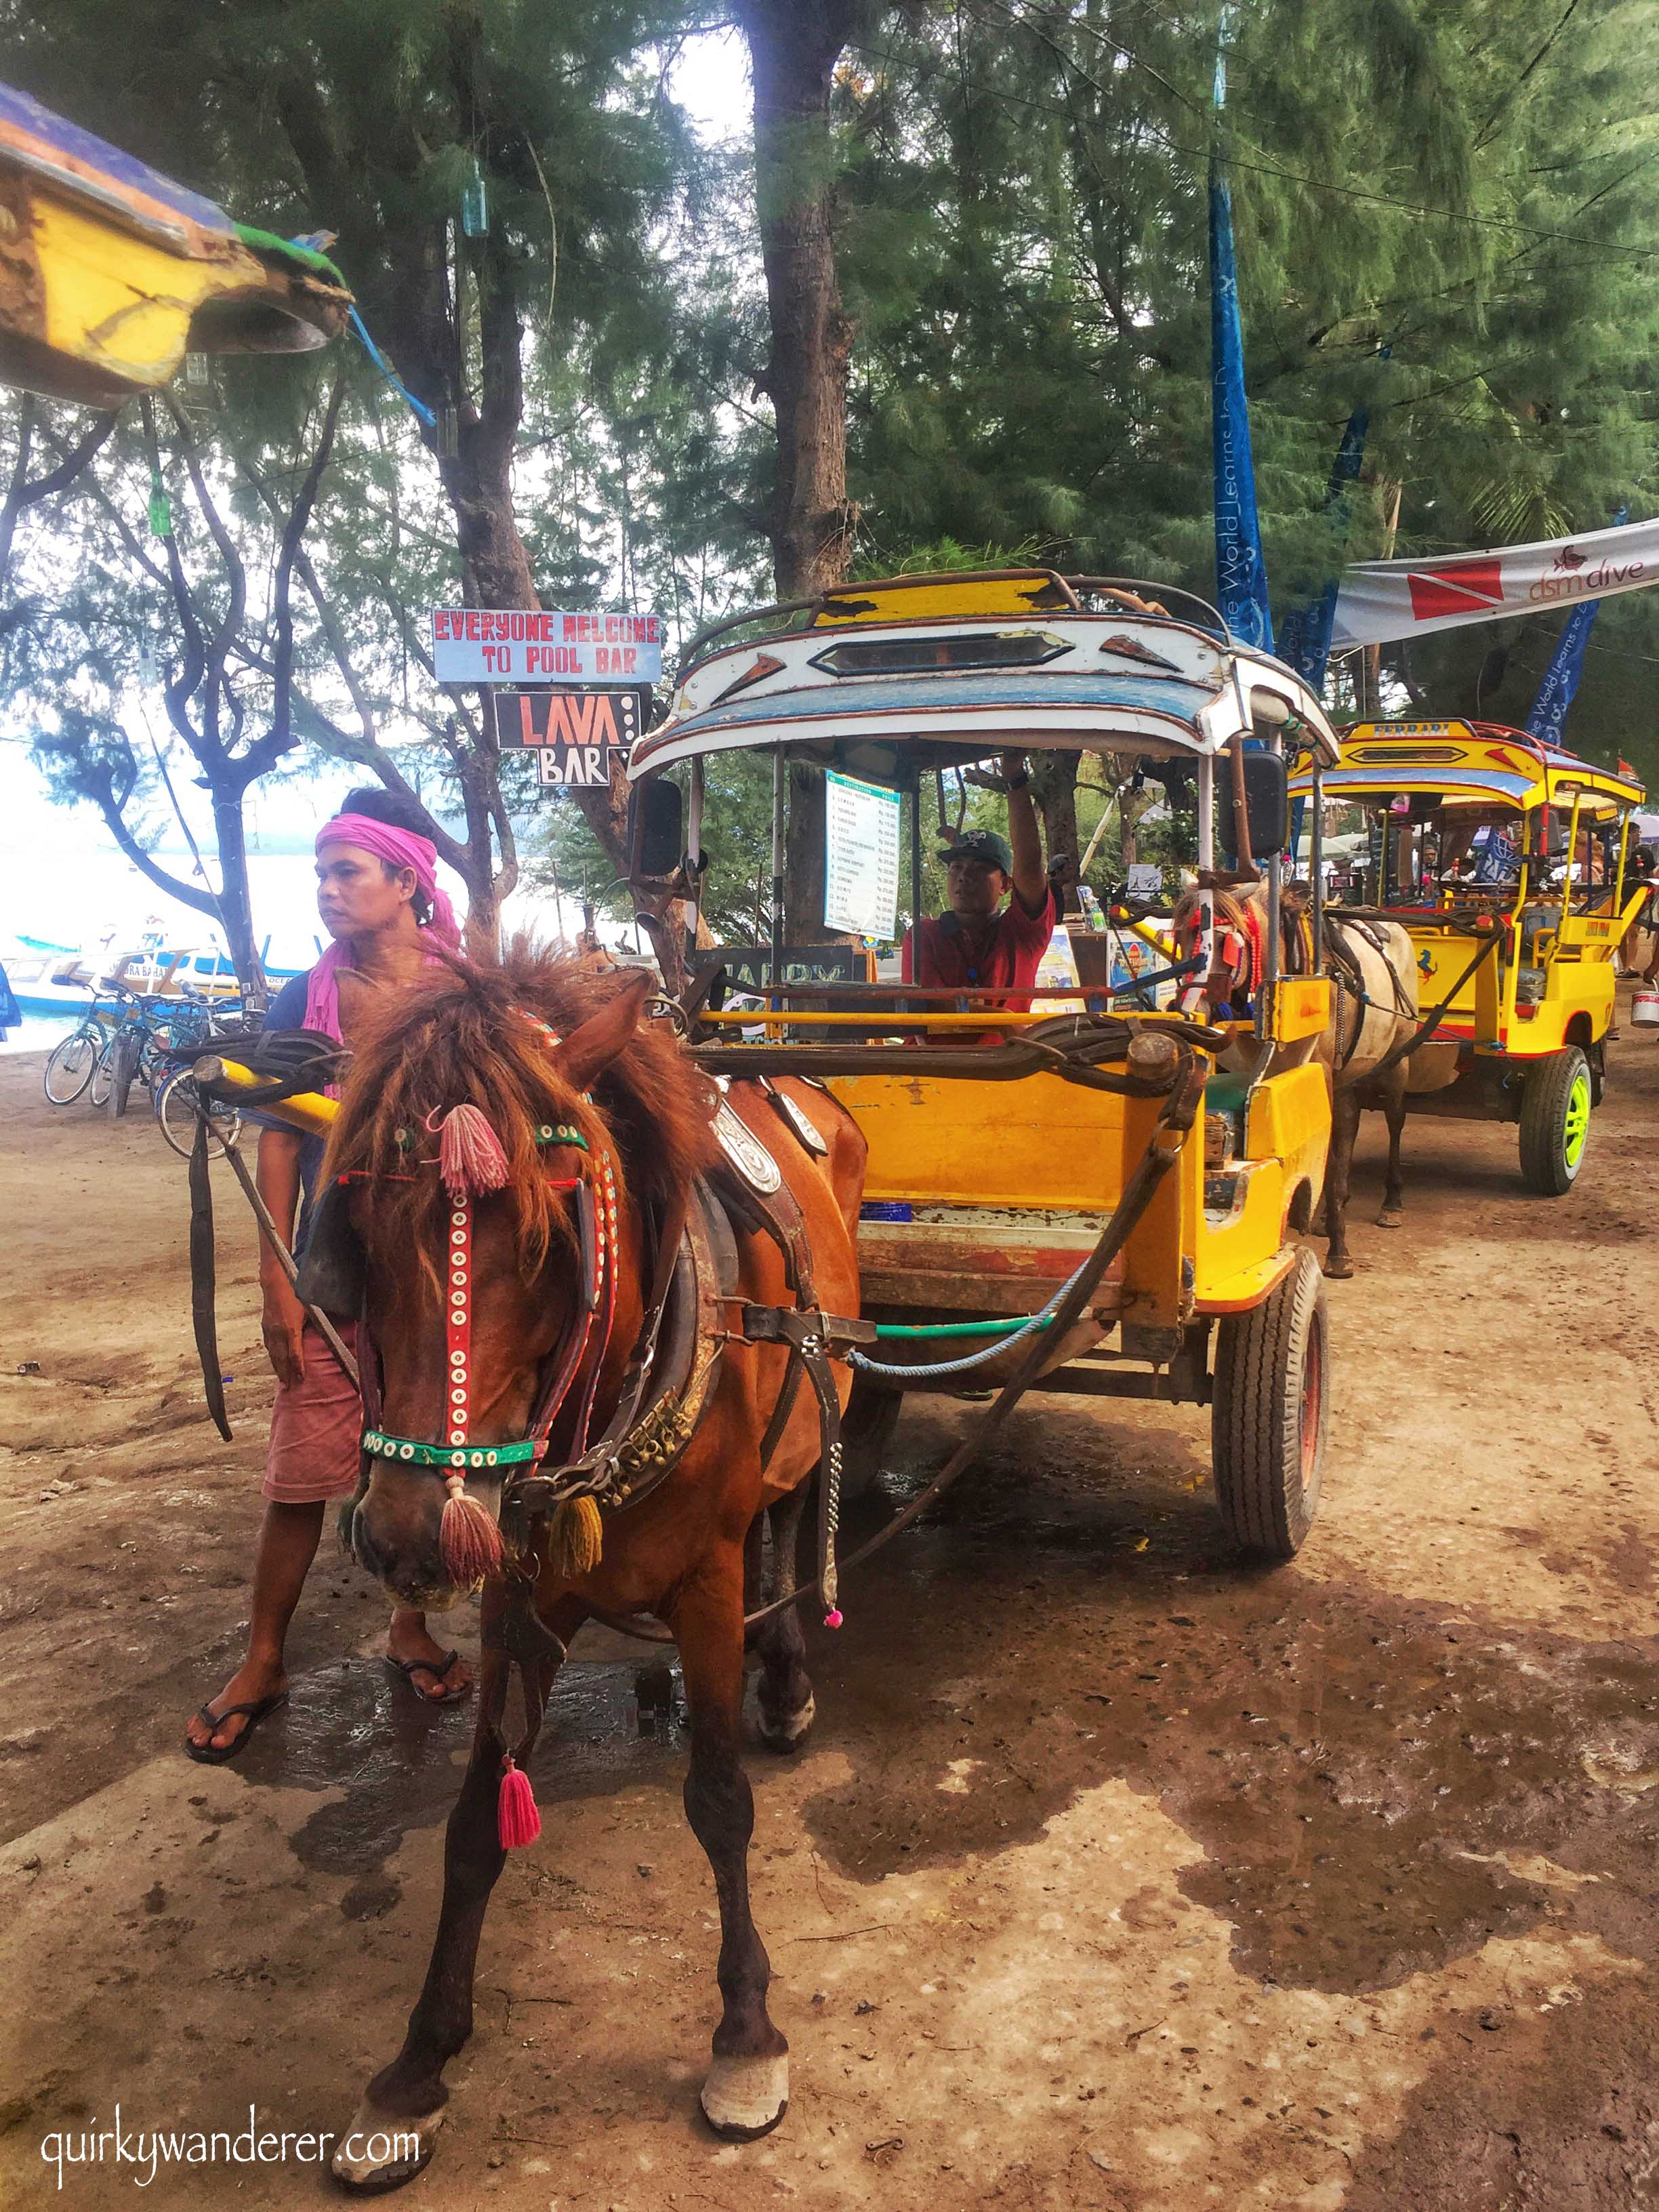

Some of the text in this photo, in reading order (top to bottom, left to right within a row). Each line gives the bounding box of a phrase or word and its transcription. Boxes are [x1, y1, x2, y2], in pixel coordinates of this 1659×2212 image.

[1217, 431, 1241, 505] Learns
[1216, 515, 1240, 592] World
[1529, 558, 1643, 600] dsm dive
[434, 611, 659, 643] EVERYONE WELCOME
[482, 646, 636, 674] TO POOL BAR
[1525, 617, 1581, 739] he World Learns to
[520, 695, 620, 745] LAVA
[1374, 724, 1449, 738] FERRARI
[541, 747, 608, 784] BAR
